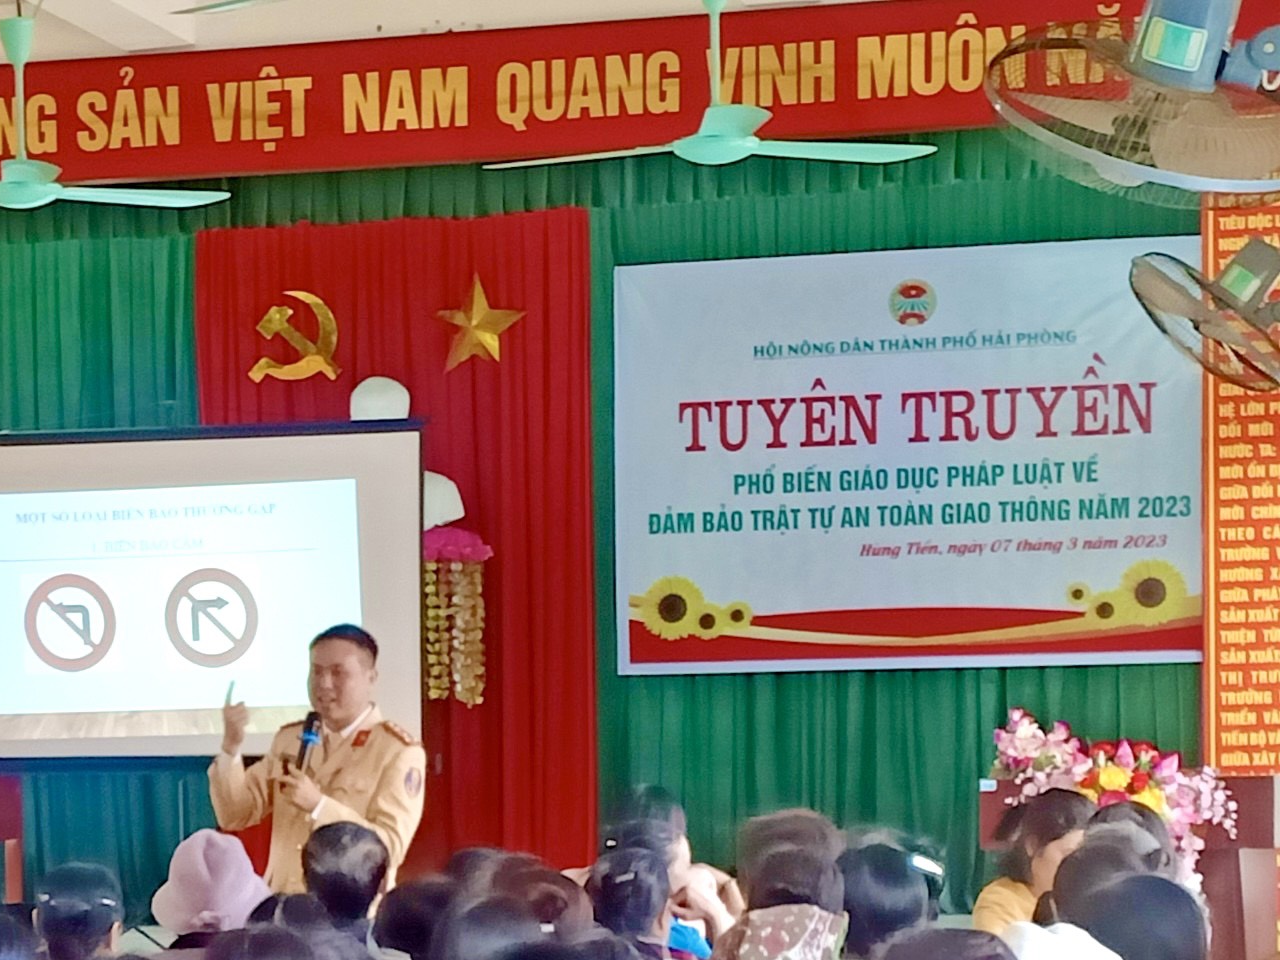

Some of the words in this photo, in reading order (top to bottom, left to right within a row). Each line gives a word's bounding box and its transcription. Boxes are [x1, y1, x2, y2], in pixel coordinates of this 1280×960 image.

[76, 66, 180, 151] SẢN
[206, 65, 312, 152] VIỆT
[342, 66, 469, 134] NAM
[496, 50, 680, 131] QUANG
[706, 39, 835, 107] VINH
[857, 12, 1026, 99] MUÔN
[1046, 3, 1141, 87] NĂ
[753, 341, 783, 359] HỘI
[788, 339, 835, 357] NÔNG
[840, 337, 874, 353] DÂN
[879, 333, 937, 351] THÀNH
[942, 328, 977, 349] PHỐ
[981, 330, 1011, 347] HẢI
[1015, 327, 1077, 345] PHÒNG
[678, 377, 883, 453] TUYÊN
[900, 351, 1158, 443] TRUYỀN
[733, 463, 776, 495] PHỔ
[782, 464, 832, 493] BIẾN
[839, 464, 889, 491] GIÁO
[896, 466, 939, 494] DỤC
[946, 460, 1005, 488] PHÁP
[1012, 457, 1065, 490] LUẬT
[648, 505, 694, 535] ĐẢM
[702, 503, 743, 532] BẢO
[751, 504, 801, 536] TRẬT
[807, 504, 836, 534] TỰ
[841, 506, 869, 528] AN
[877, 500, 933, 526] TOÀN
[941, 501, 991, 525] GIAO
[998, 495, 1071, 523] THÔNG
[1078, 493, 1130, 520] NĂM
[1138, 495, 1191, 518] 2023
[947, 539, 987, 557] ngày
[990, 539, 1012, 553] 07
[1016, 537, 1063, 554] tháng
[1067, 537, 1078, 551] 3
[1082, 536, 1119, 550] năm
[1123, 534, 1168, 549] 2023
[1219, 527, 1255, 541] THEO
